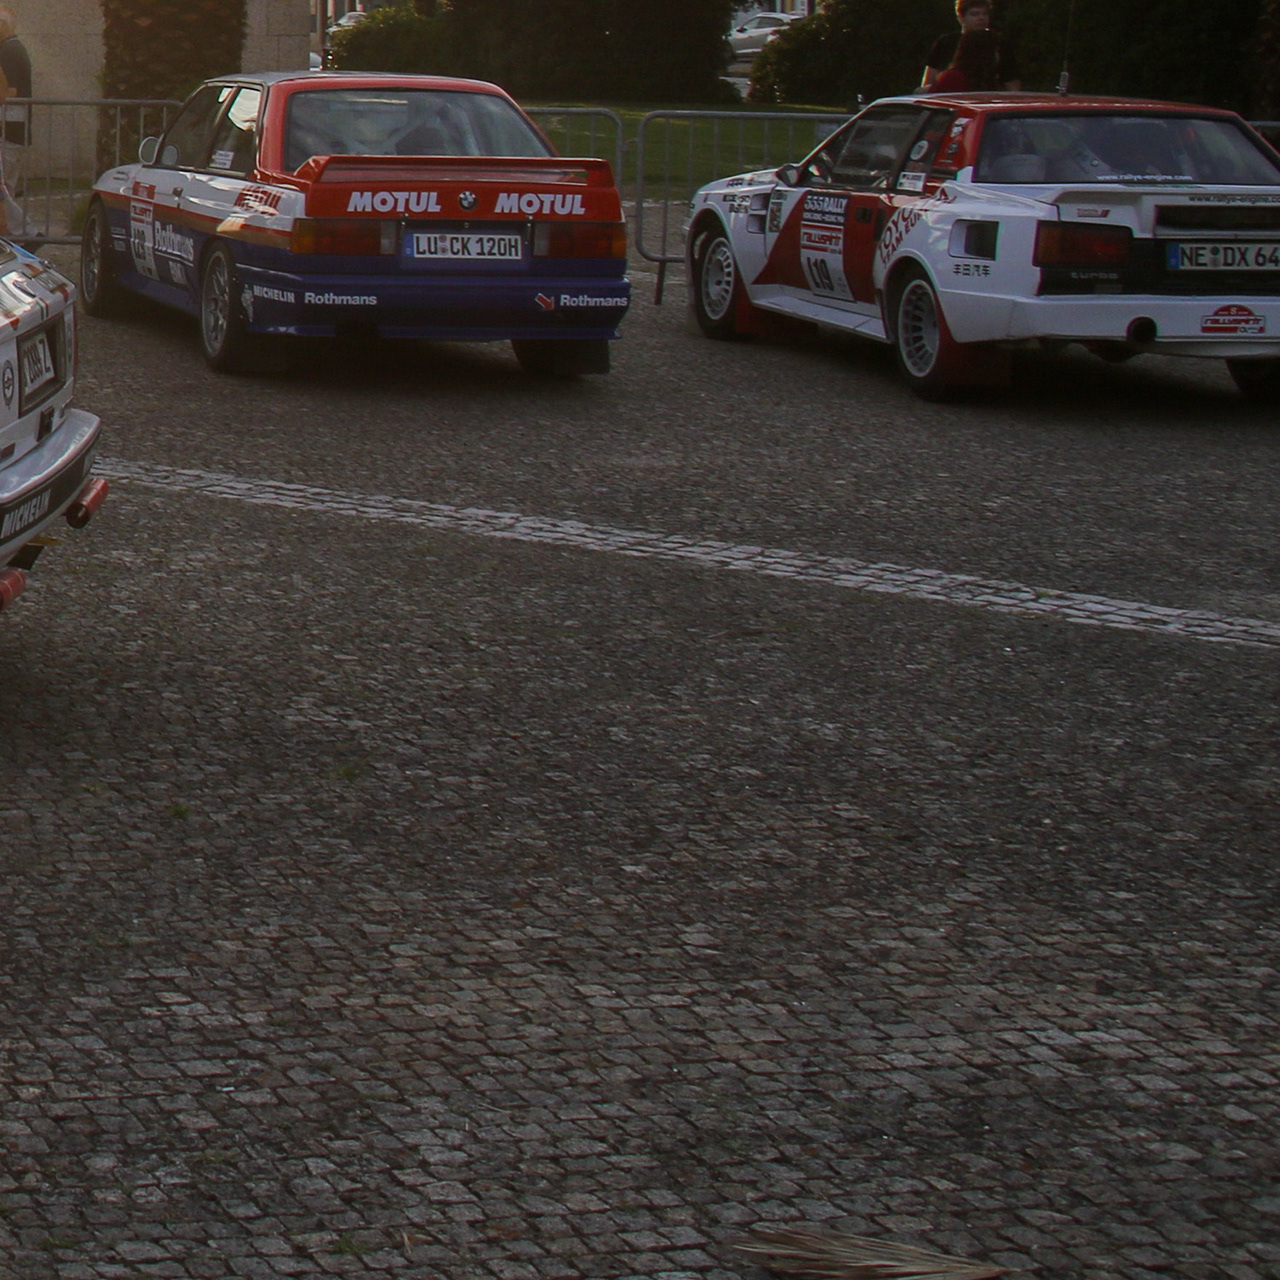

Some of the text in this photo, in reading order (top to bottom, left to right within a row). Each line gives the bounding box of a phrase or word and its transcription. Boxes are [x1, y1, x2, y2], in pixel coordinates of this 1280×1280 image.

[347, 191, 441, 213] MOTUL
[494, 193, 586, 216] MOTUL
[804, 195, 849, 214] 555 RALLY
[155, 220, 194, 261] Rothmans
[415, 235, 520, 258] LU CK 120H
[1180, 247, 1207, 266] NE
[1223, 247, 1250, 266] DX
[253, 284, 378, 307] MICHELIN Rothmans
[559, 293, 628, 308] Rothmans
[0, 489, 51, 540] MICHELIN
